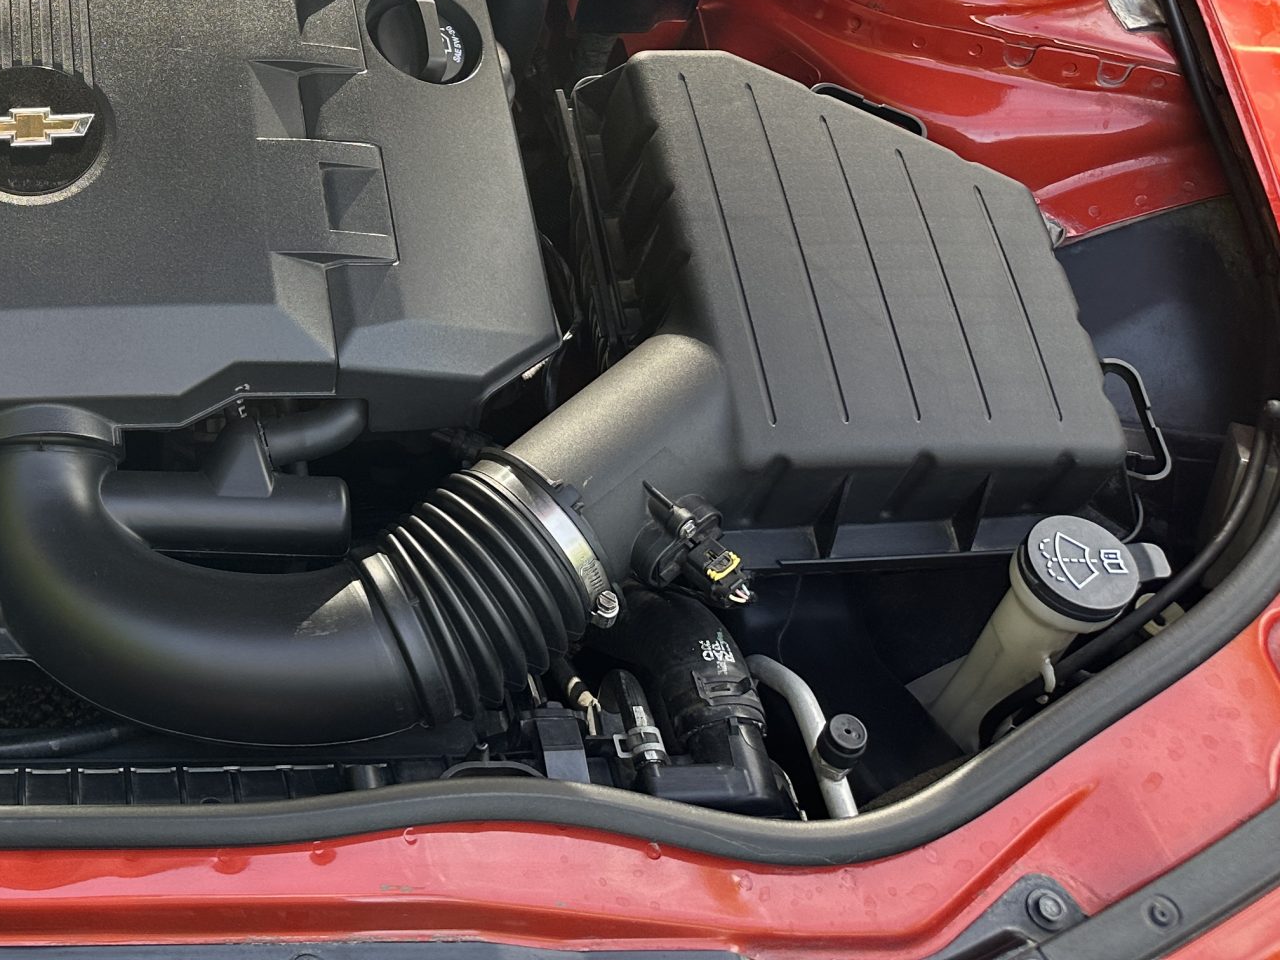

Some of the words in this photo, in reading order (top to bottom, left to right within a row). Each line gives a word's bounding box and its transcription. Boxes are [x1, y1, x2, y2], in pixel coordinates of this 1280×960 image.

[445, 25, 462, 49] 5W-30
[452, 48, 462, 63] SAE
[702, 650, 736, 663] RAD
